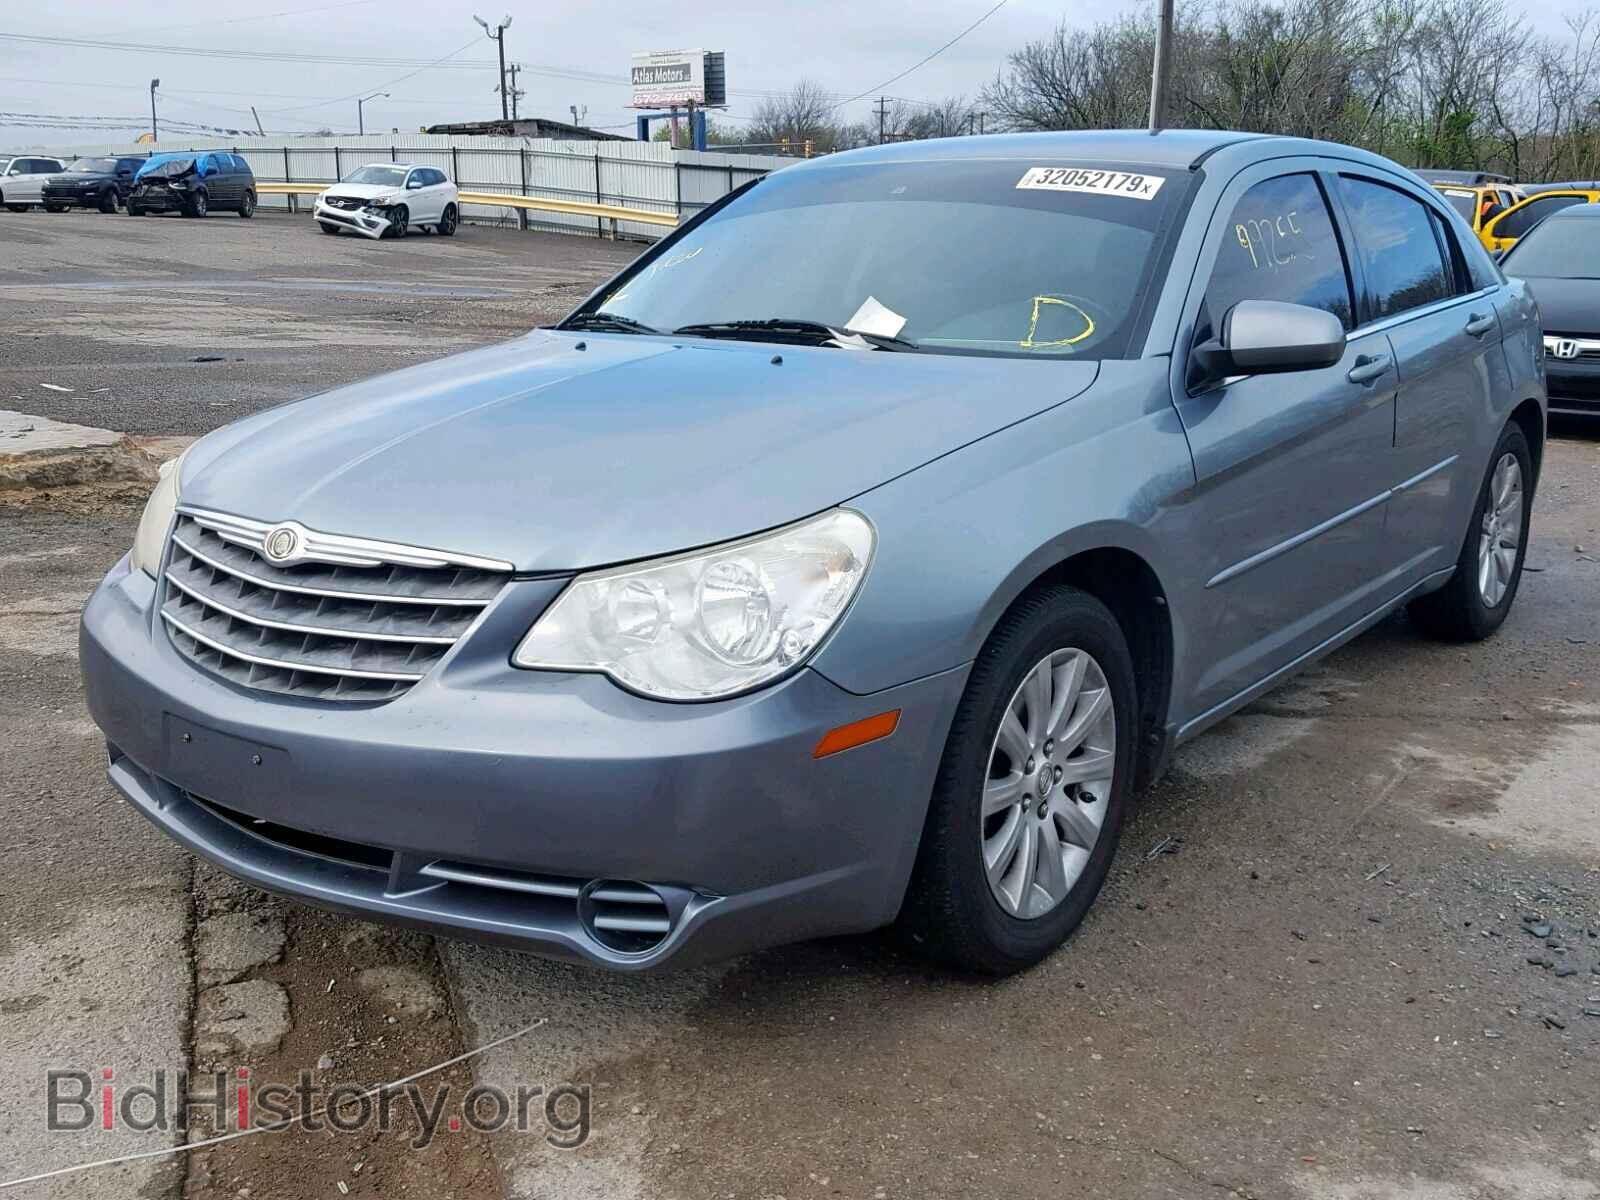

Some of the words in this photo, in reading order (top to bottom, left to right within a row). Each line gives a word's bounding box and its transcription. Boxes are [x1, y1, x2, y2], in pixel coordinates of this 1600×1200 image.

[633, 69, 654, 84] Atlas
[655, 68, 684, 82] Motors
[1018, 297, 1095, 346] D
